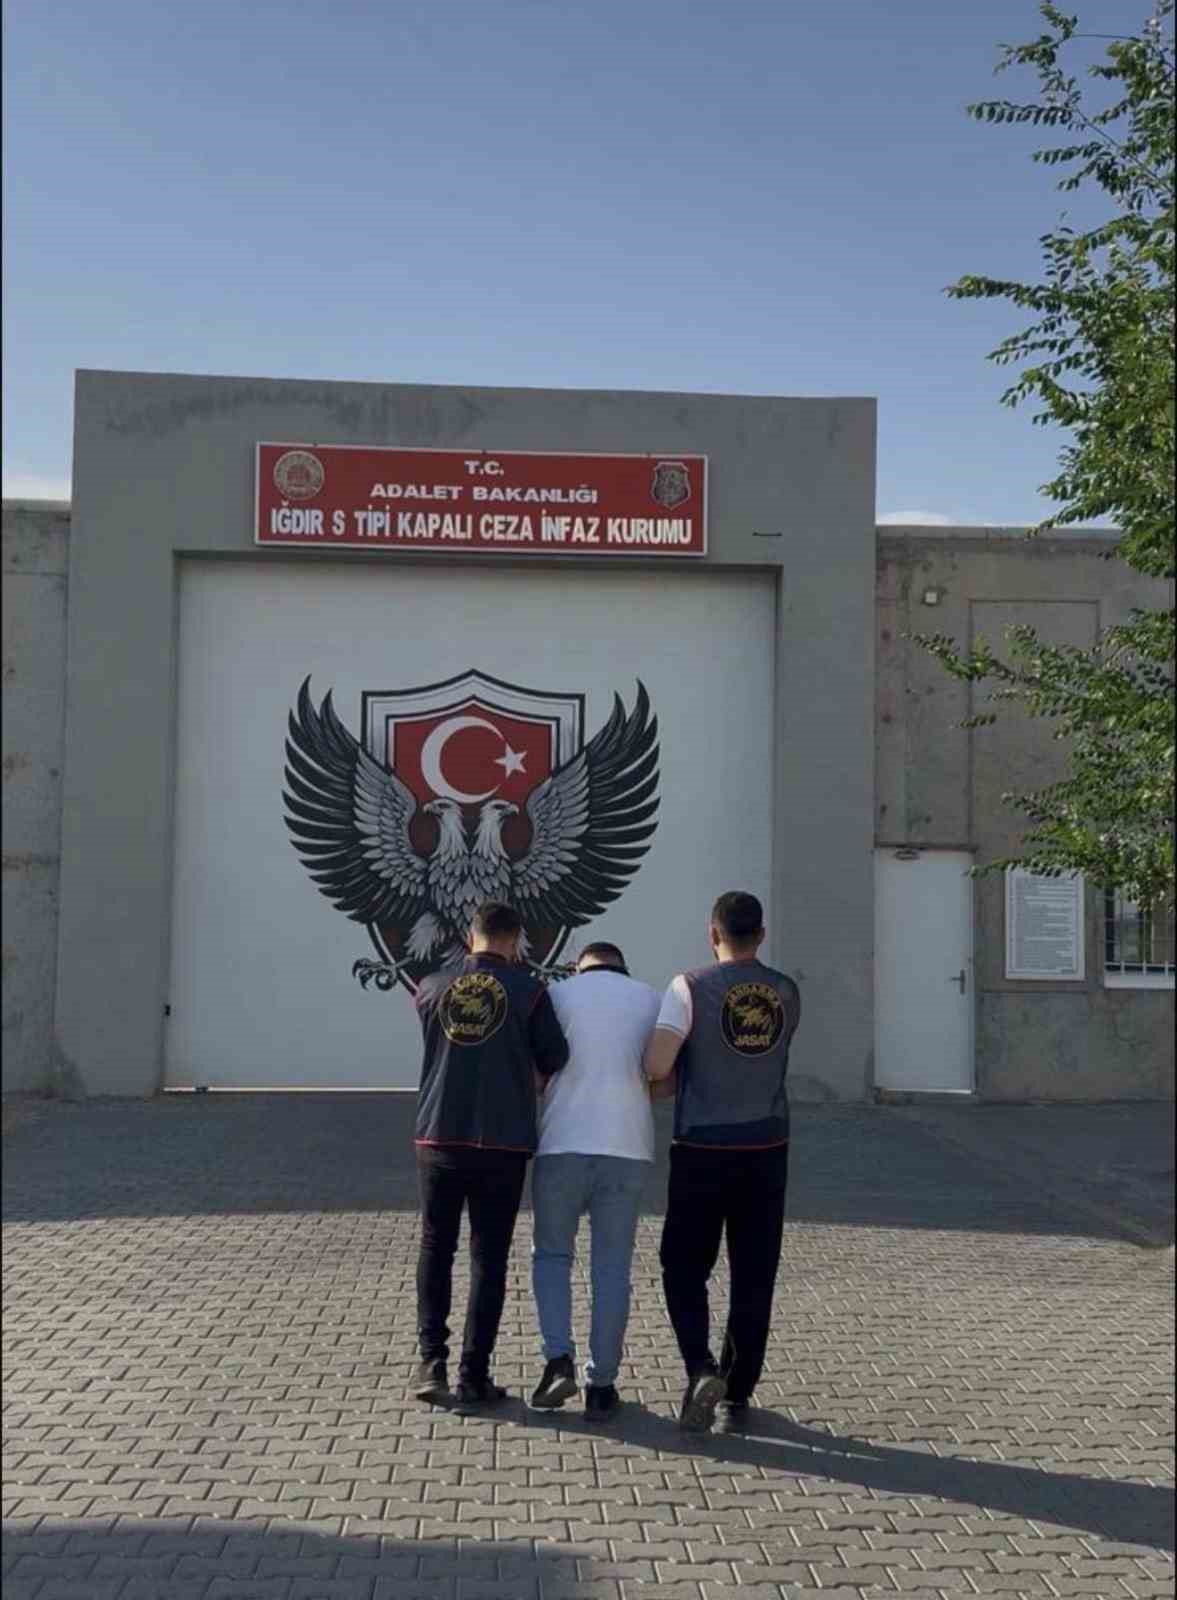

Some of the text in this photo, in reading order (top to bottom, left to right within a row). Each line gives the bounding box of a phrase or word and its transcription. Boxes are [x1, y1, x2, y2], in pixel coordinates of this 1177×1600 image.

[464, 460, 505, 475] T.C.
[370, 483, 598, 504] ADALET BAKANLIĞI
[271, 501, 693, 545] IĞDIR S TİPİ KAPALI CEZA İNFAZ KURUMU
